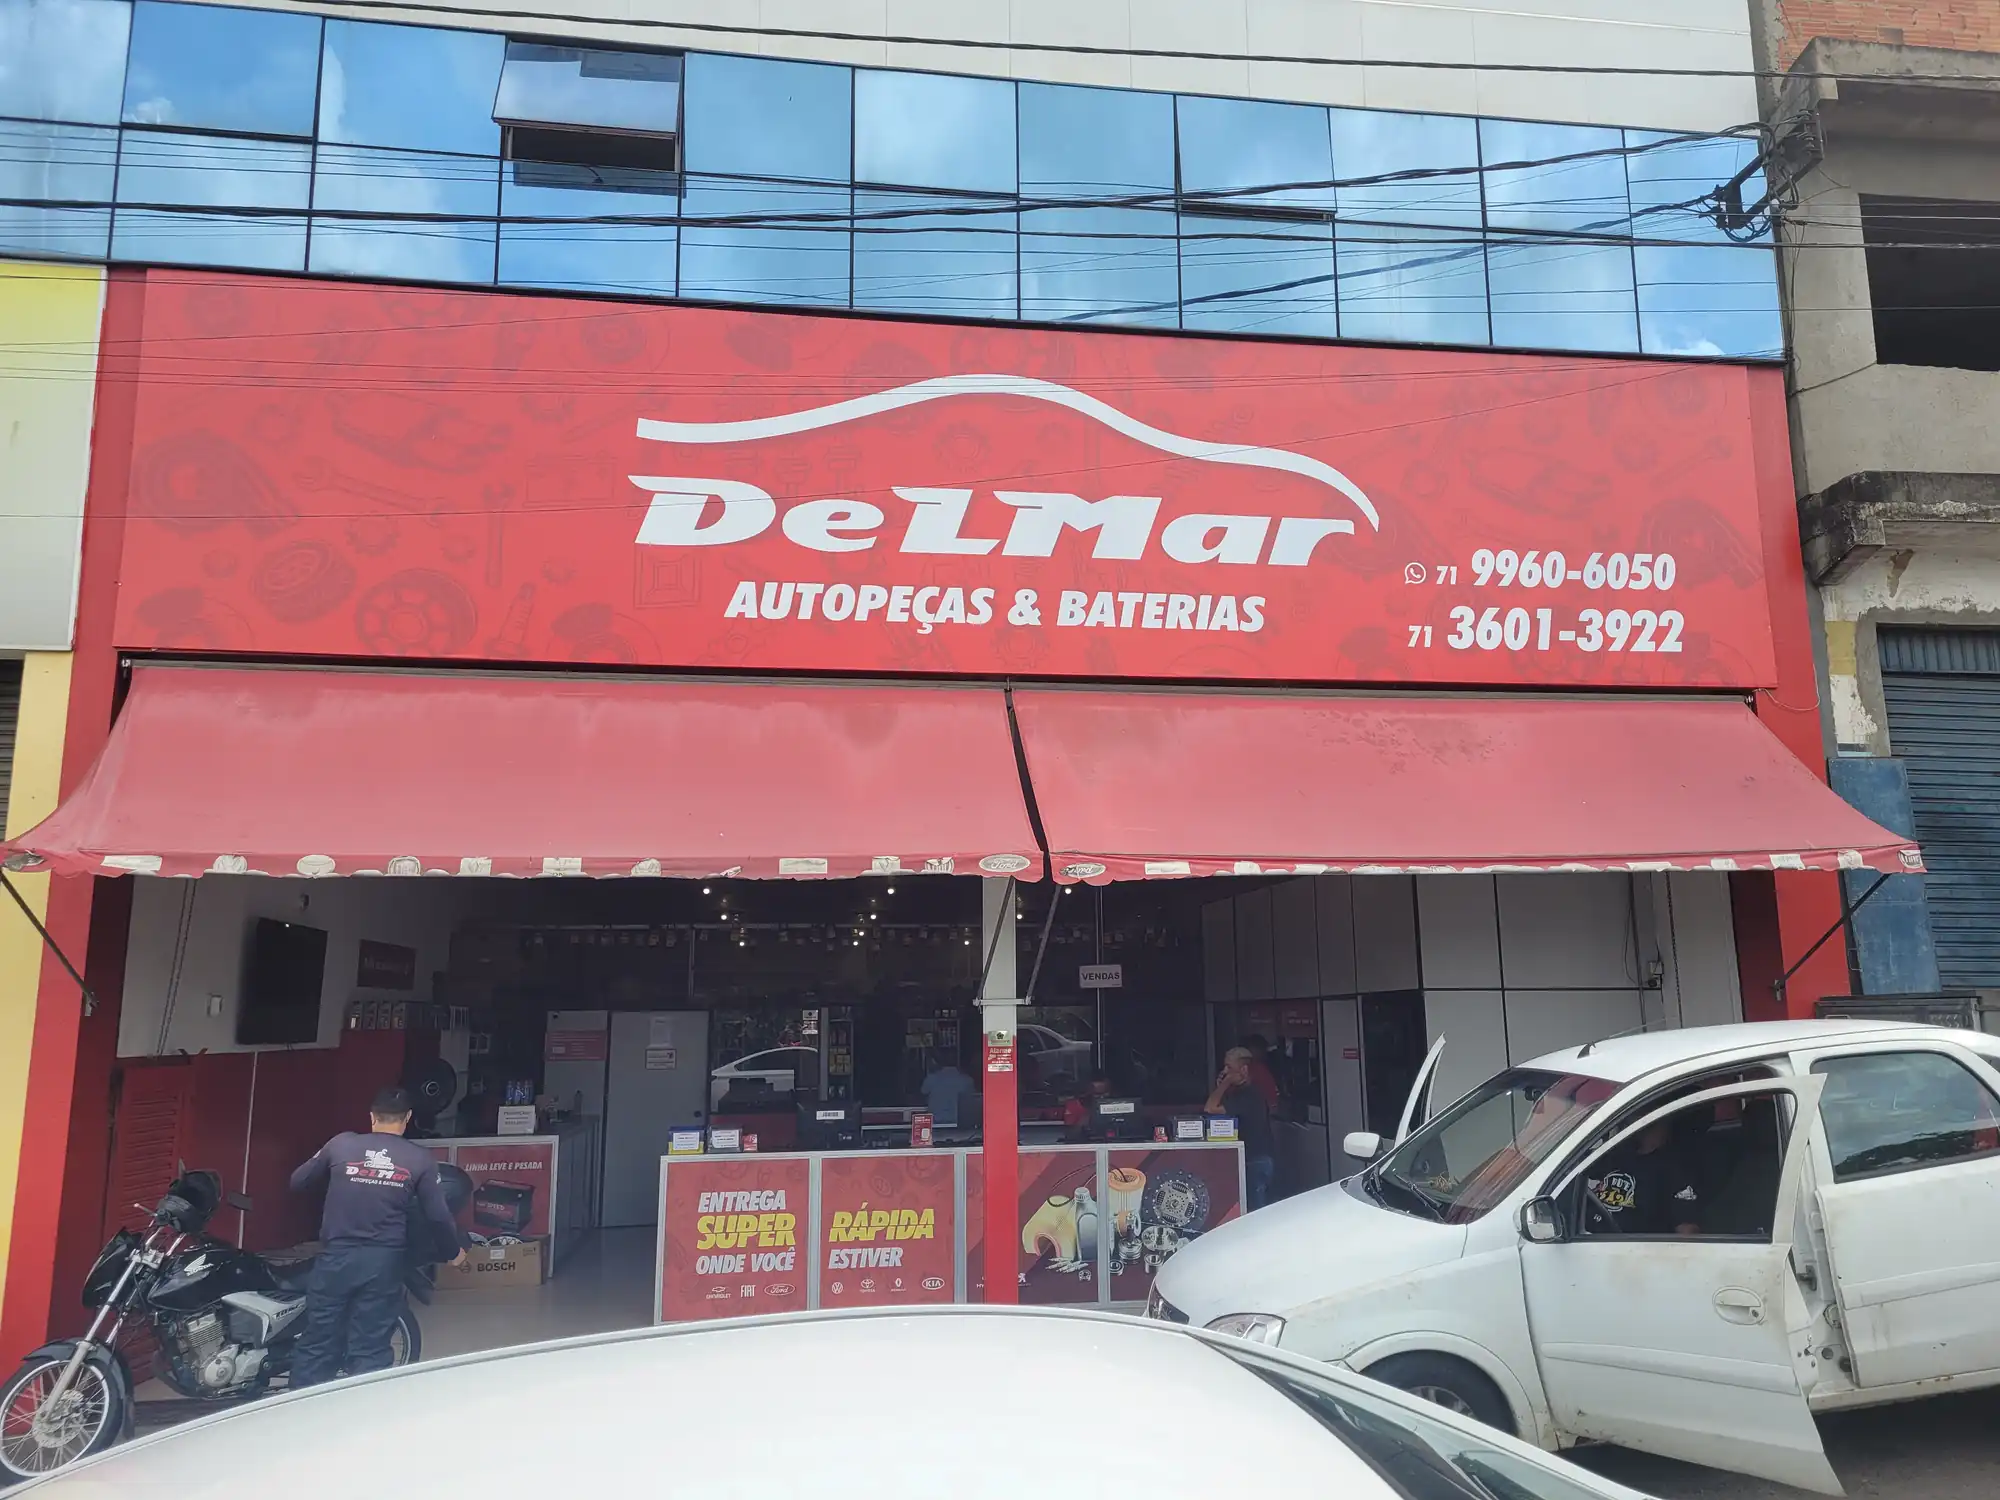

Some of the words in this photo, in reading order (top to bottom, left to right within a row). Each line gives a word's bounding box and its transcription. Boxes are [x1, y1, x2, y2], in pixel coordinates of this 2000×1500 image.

[1436, 566, 1457, 585] 71
[1471, 549, 1677, 591] 9960-6050
[724, 581, 994, 634] AUTOPEÇAS
[1007, 589, 1041, 627] &
[1057, 591, 1267, 633] BATERIAS
[1407, 625, 1432, 648] 71
[1447, 605, 1685, 653] 3601-3922
[1081, 971, 1121, 981] VENDAS
[465, 1163, 488, 1172] LINHA
[489, 1162, 507, 1171] LEVE
[508, 1162, 513, 1170] E
[514, 1161, 543, 1170] PESADA
[697, 1190, 786, 1213] ENTREGA
[696, 1213, 796, 1249] SUPER
[829, 1202, 935, 1242] RÁPIDA
[477, 1261, 516, 1272] BOSCH
[695, 1254, 745, 1275] ONDE
[751, 1247, 796, 1272] VOCÊ
[828, 1247, 903, 1270] ESTIVER
[741, 1285, 756, 1297] FIAT
